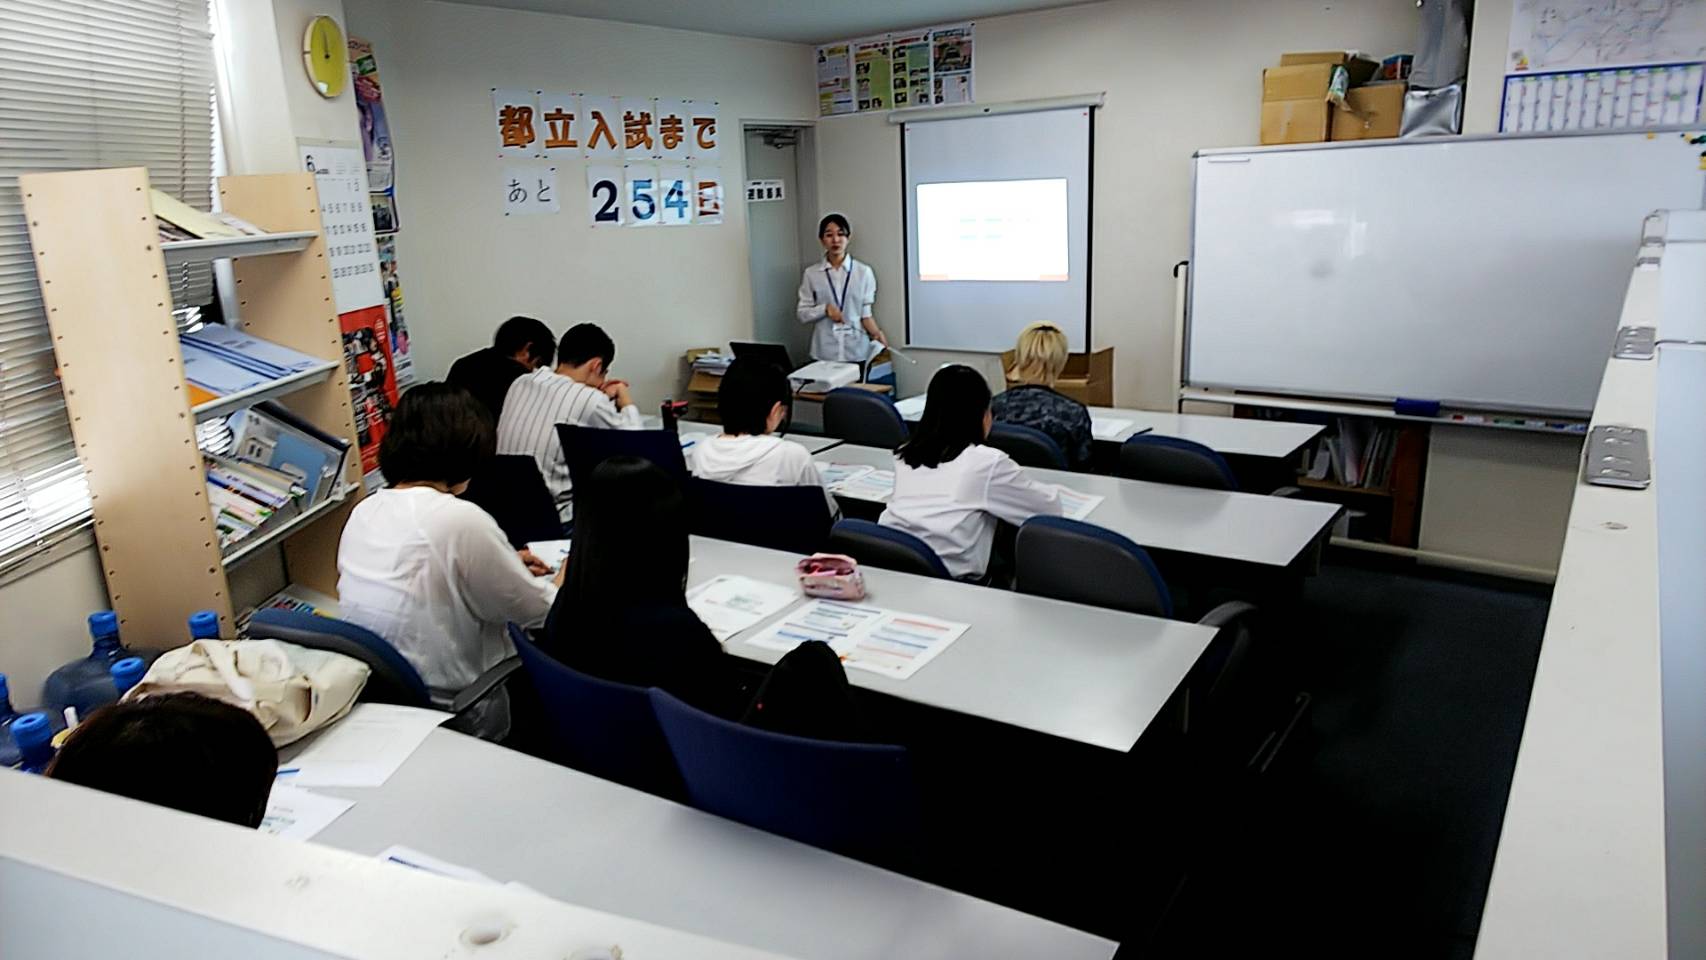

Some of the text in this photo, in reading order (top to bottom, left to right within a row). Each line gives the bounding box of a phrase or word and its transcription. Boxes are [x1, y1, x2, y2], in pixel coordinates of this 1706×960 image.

[498, 105, 716, 150] 都立入試まで
[306, 155, 315, 172] 6
[507, 178, 551, 203] あと
